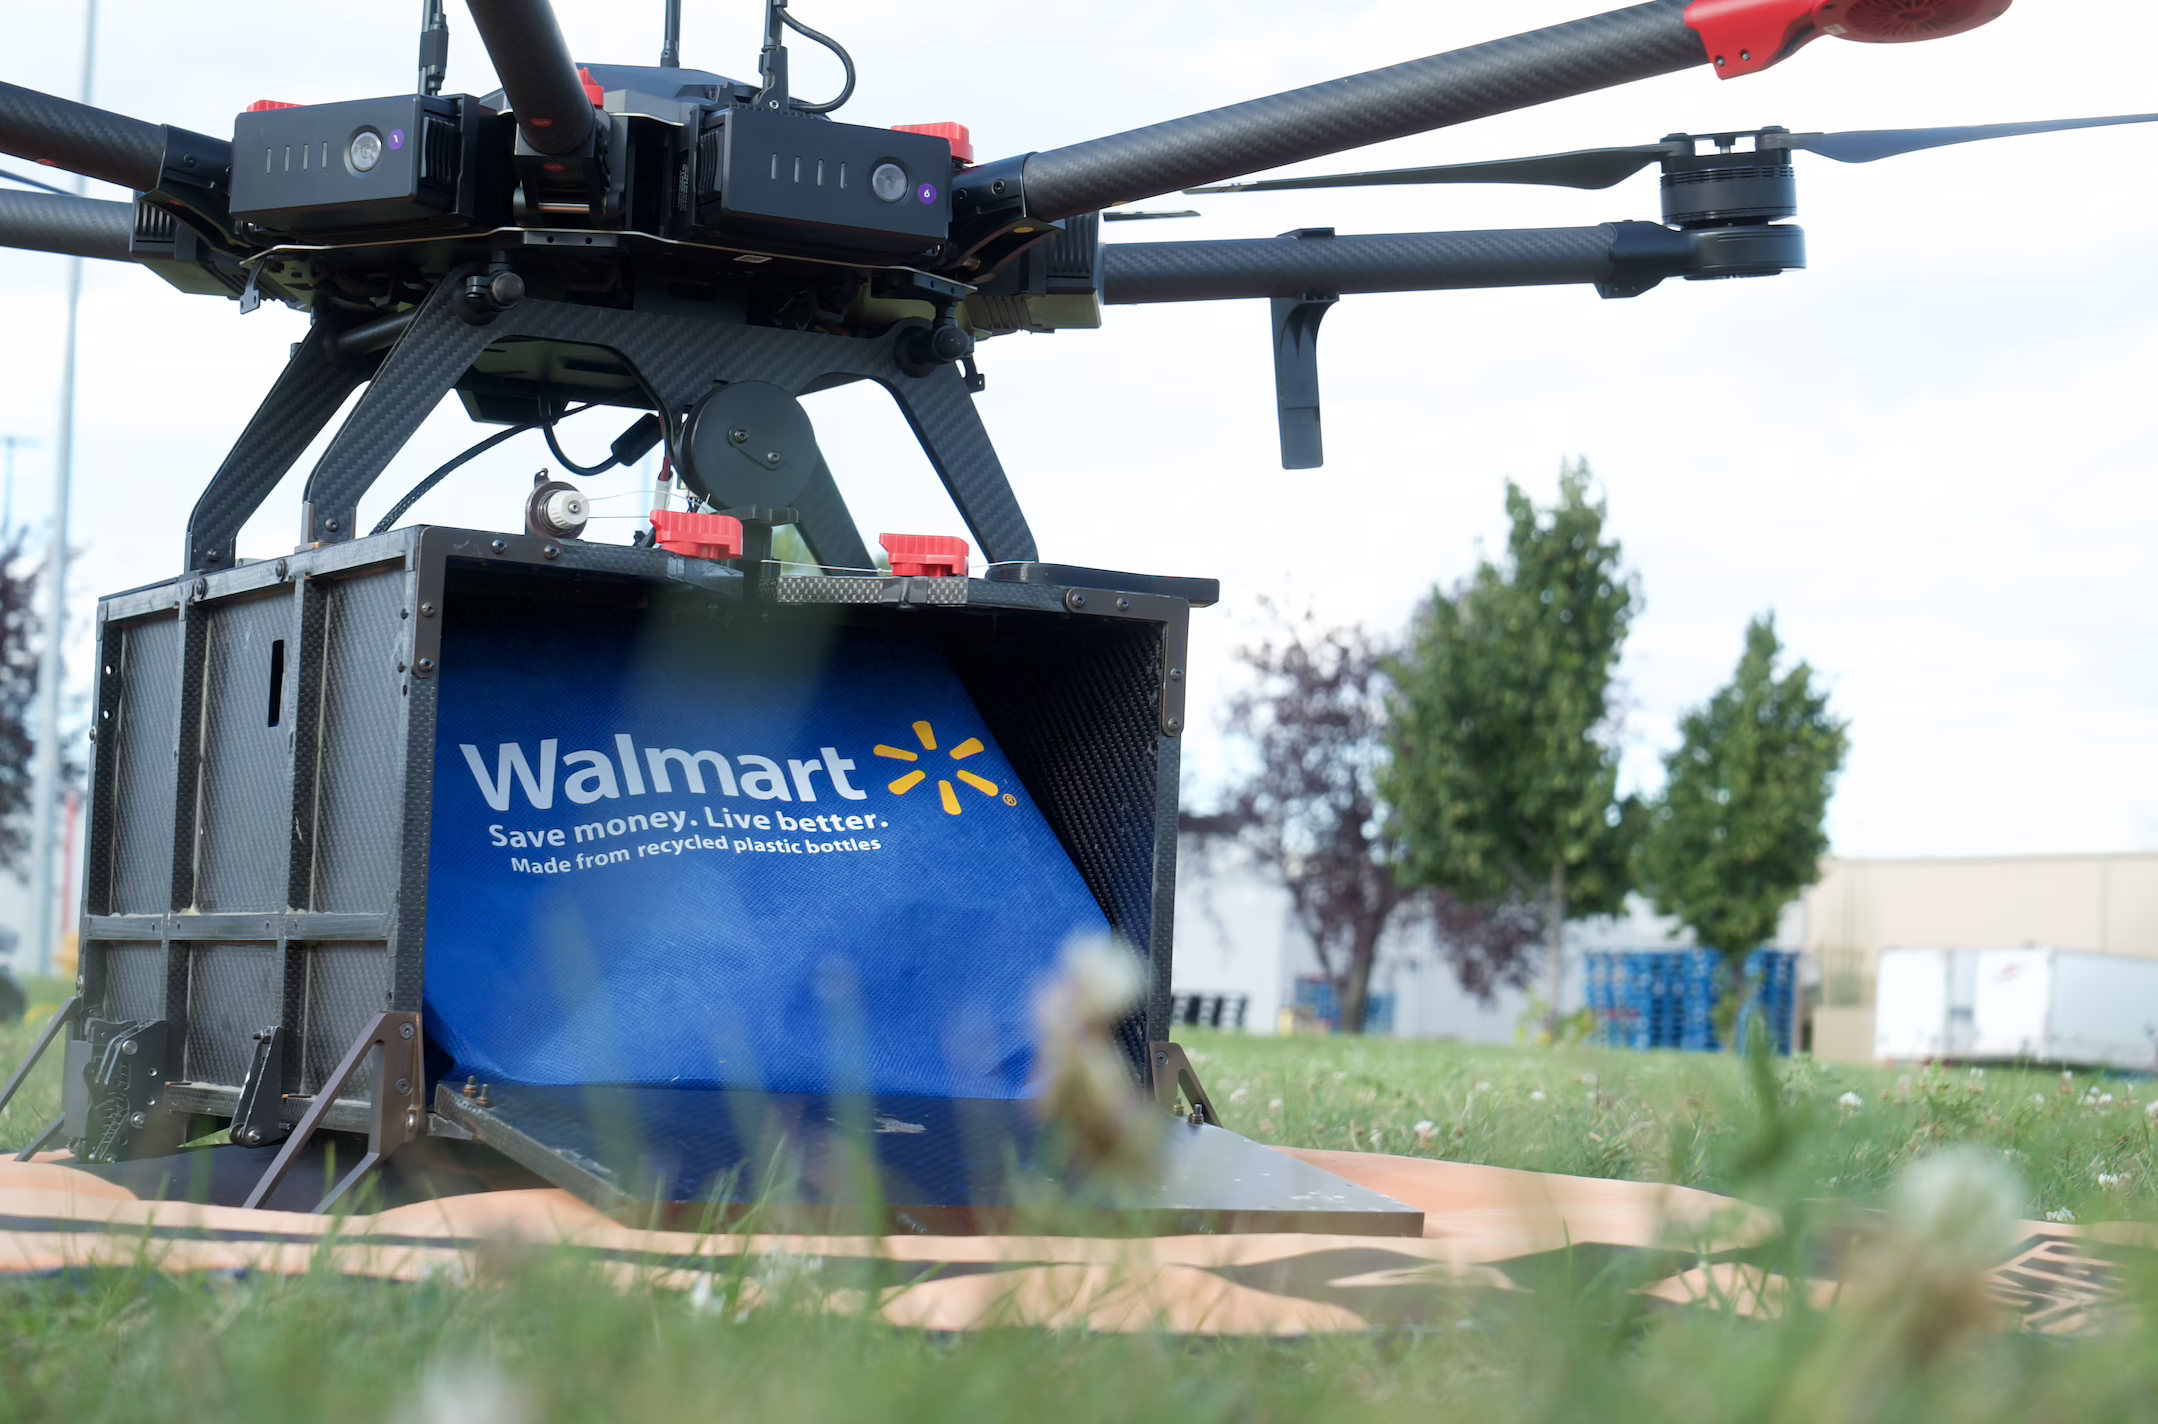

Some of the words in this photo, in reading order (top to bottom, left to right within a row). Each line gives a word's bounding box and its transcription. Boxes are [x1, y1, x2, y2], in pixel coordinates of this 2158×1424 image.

[923, 188, 931, 198] 6
[459, 733, 867, 812] Walmart
[488, 824, 565, 848] Save
[574, 810, 698, 844] money.
[704, 806, 771, 831] Live
[776, 811, 889, 832] better.
[511, 857, 571, 874] Made
[576, 848, 630, 870] from
[637, 834, 729, 858] recycled
[733, 836, 802, 854] plastic
[805, 838, 882, 854] bottles
